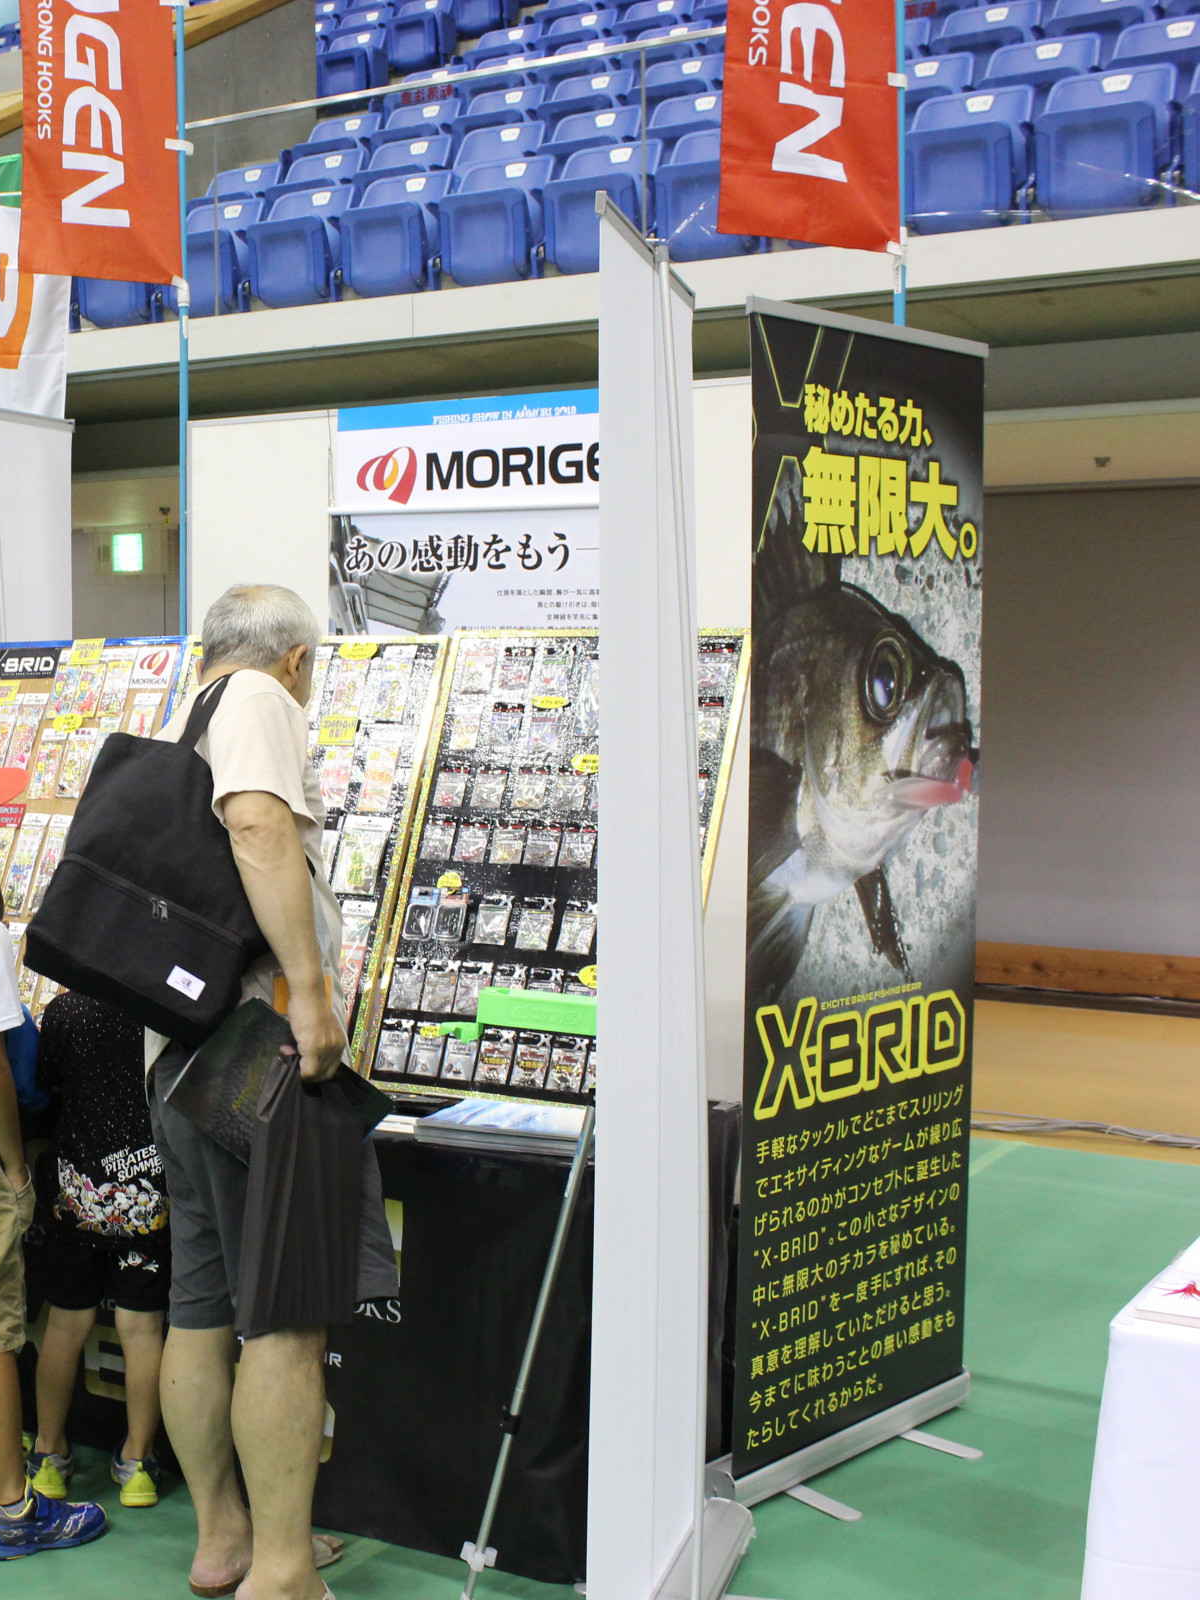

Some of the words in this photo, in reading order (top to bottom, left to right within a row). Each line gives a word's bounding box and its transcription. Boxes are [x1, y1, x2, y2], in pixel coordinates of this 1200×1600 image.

[37, 61, 53, 140] HOOKS
[432, 414, 470, 425] FISHING
[472, 411, 500, 423] SHOW
[502, 410, 513, 421] IN
[554, 406, 577, 416] 2018
[803, 383, 932, 447] 秘めたる力、
[802, 447, 978, 560] 無限大。
[131, 677, 168, 685] MORIGEN
[820, 996, 851, 1011] EXCITE
[851, 992, 874, 1004] GAME
[874, 986, 901, 1000] FISHING
[901, 981, 923, 993] GEAR
[101, 1146, 130, 1167] DISNEY
[105, 1144, 157, 1176] PIRATES
[755, 1117, 963, 1199] でエキサイティングなゲームが繰り広
[756, 1083, 965, 1165] 手軽なタックルでどこまでスリリング
[150, 1165, 163, 1176] 20
[754, 1150, 962, 1237] げられるのかがコンセプトに誕生した
[752, 1216, 956, 1307] 中に無限大のチカラを秘めている。
[749, 1308, 956, 1414] 今までに味わうことの無い感動をも
[750, 1281, 951, 1380] 真意を理解していただけると思う。
[746, 1380, 884, 1450] たらしてくれるからだ。
